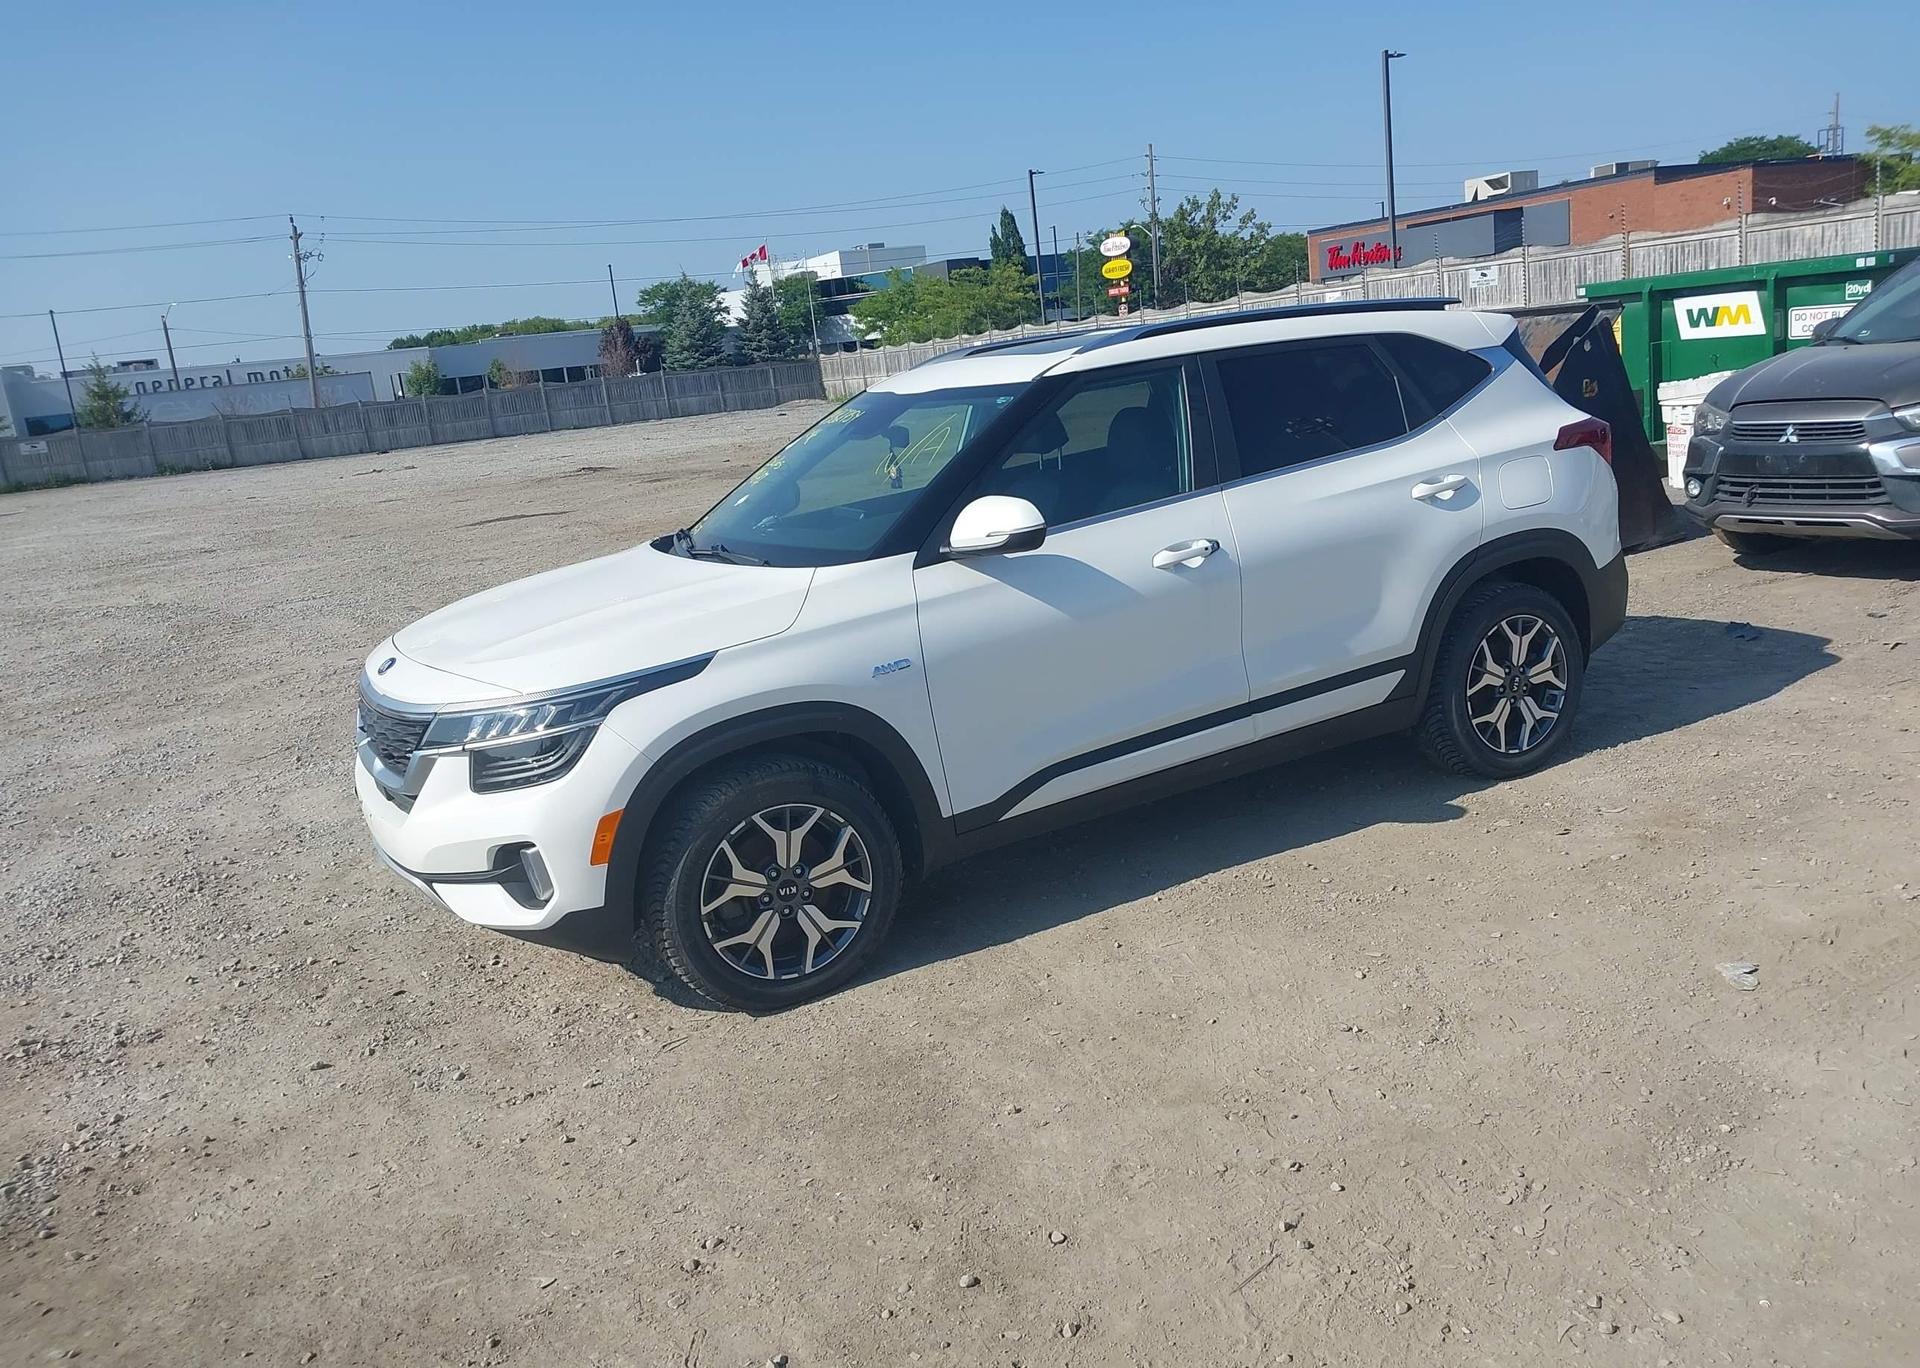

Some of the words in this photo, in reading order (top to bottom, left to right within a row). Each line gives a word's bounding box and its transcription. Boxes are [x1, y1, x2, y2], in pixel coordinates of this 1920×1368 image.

[1327, 246, 1350, 271] Tim
[1847, 281, 1871, 296] 20yd
[1686, 304, 1752, 328] WM
[1794, 312, 1808, 321] DO
[1809, 311, 1828, 321] NOT
[872, 658, 912, 678] AWD
[779, 885, 797, 895] KIA
